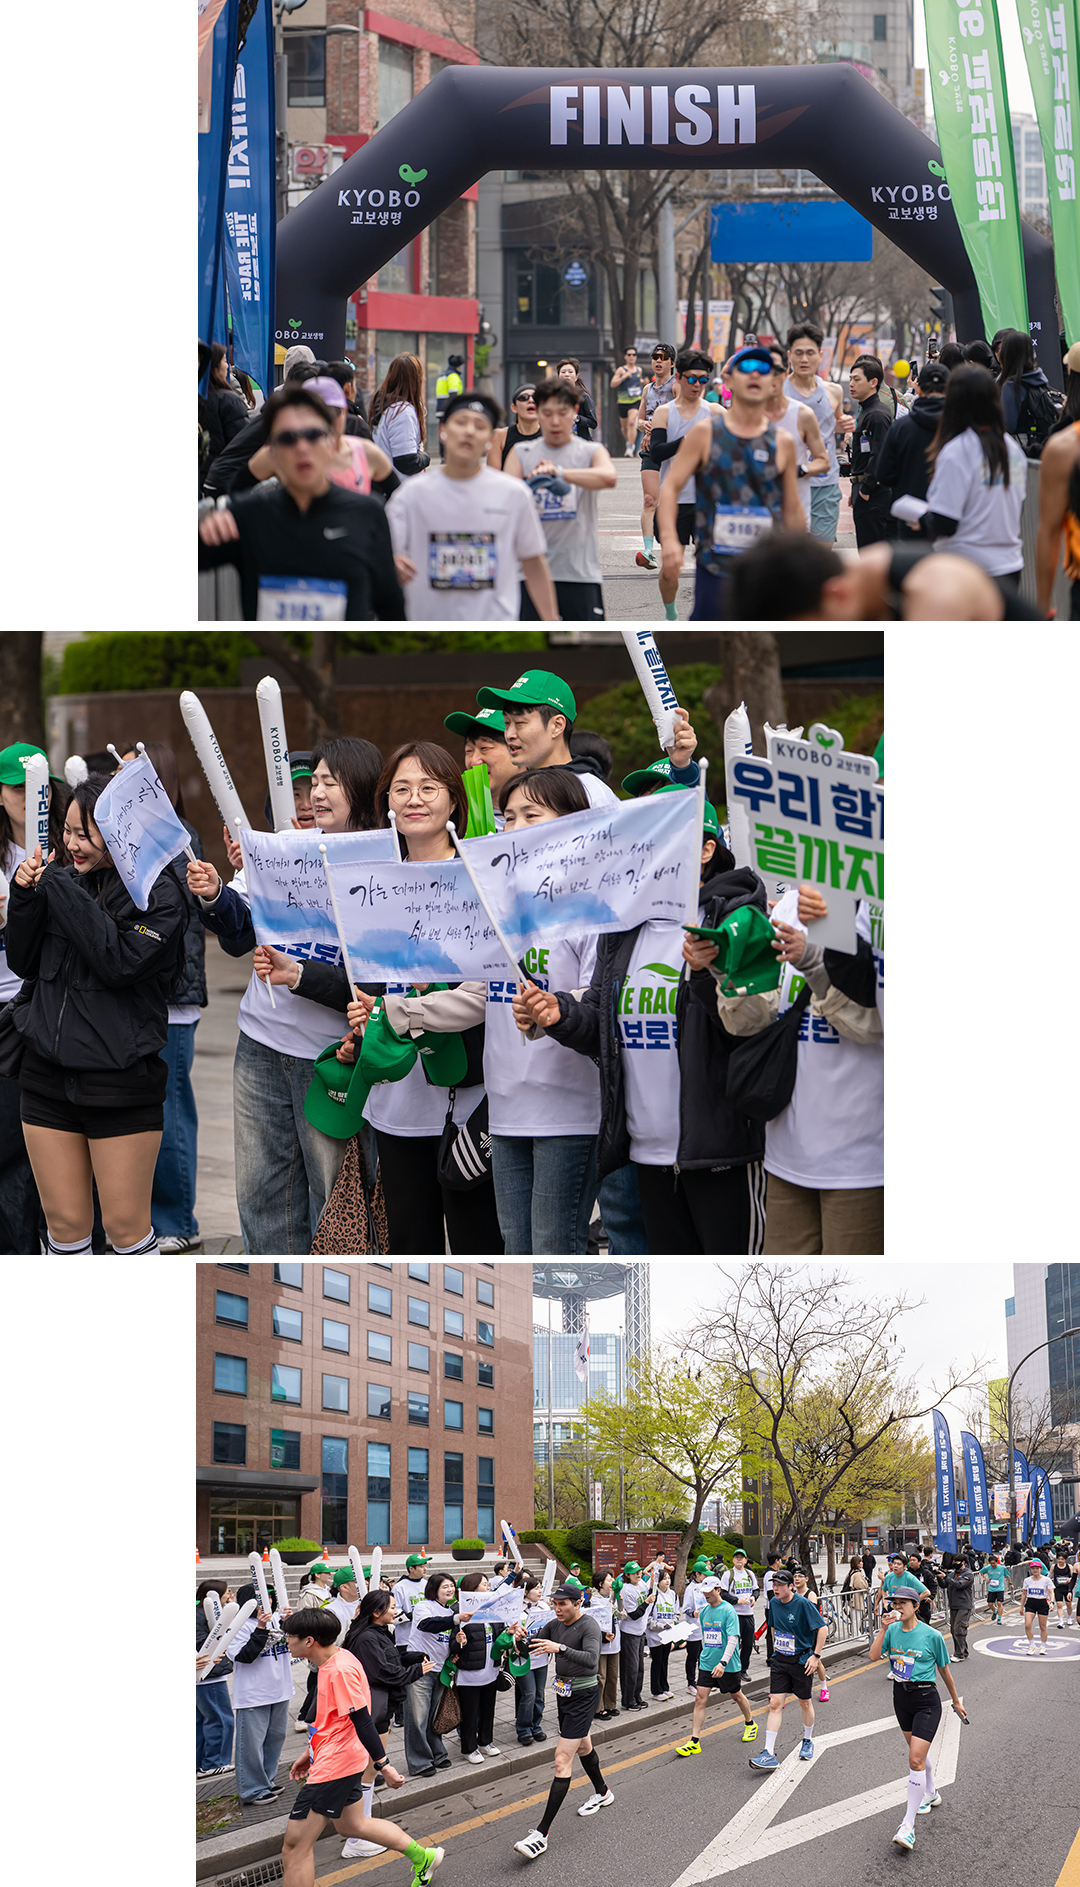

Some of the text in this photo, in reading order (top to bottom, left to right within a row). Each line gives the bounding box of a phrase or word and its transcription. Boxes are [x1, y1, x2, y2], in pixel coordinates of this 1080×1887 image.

[549, 85, 757, 146] FINISH
[337, 189, 421, 208] KYOBO
[871, 184, 952, 203] KYOBO
[350, 210, 402, 226] 교보생명
[888, 205, 938, 220] 교보생명
[301, 332, 324, 340] 교보생명
[209, 733, 226, 768] KYOBO
[270, 727, 282, 763] KYOBO
[776, 742, 871, 776] KYOBO 교보생명
[37, 785, 49, 816] 우리
[733, 762, 822, 827] 우리
[249, 846, 263, 874] 가는
[491, 841, 529, 876] 가는
[572, 823, 621, 850] 가거라
[533, 875, 563, 902] 쉬다
[570, 878, 592, 894] 보면
[598, 871, 622, 890] 새로운
[626, 859, 648, 895] 길이
[560, 855, 590, 876] 막히면
[349, 875, 458, 907] 가는 데까지 가거라
[404, 902, 421, 914] 가다
[425, 901, 442, 921] 막히면
[408, 920, 427, 945] 쉬다
[428, 928, 442, 941] 보면
[443, 927, 462, 942] 새로운
[464, 916, 480, 950] 길이
[617, 1020, 678, 1050] 보로
